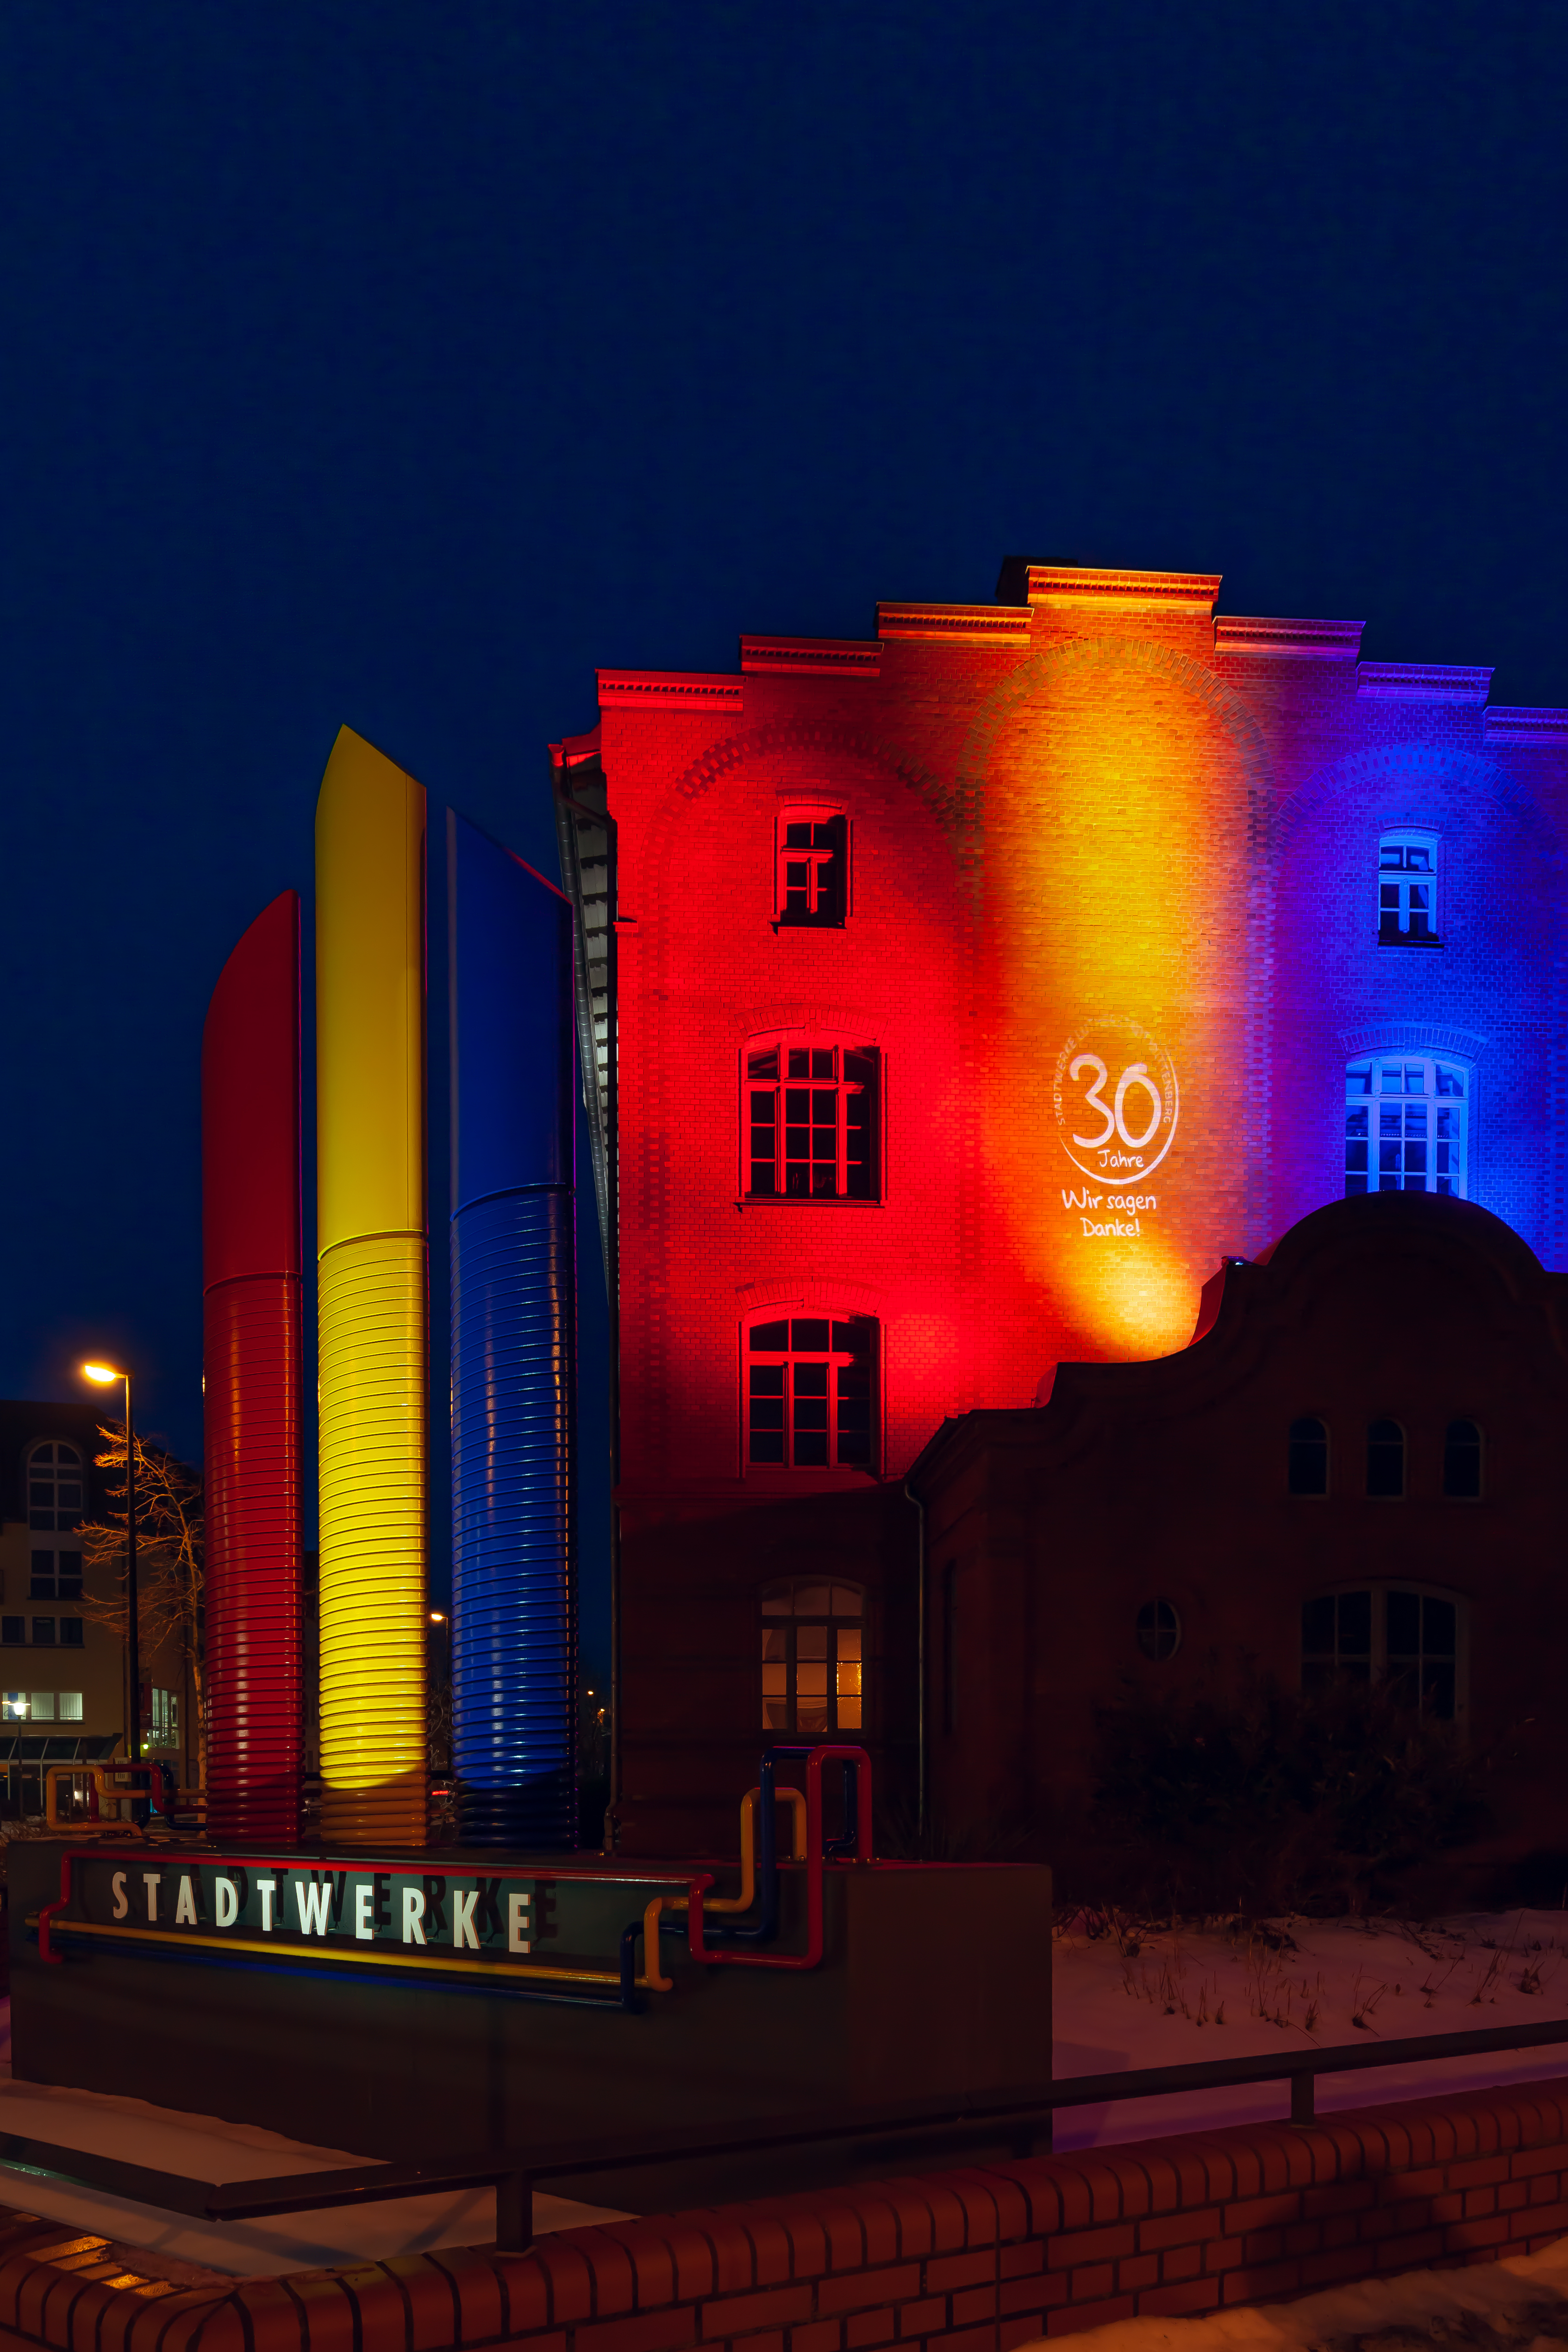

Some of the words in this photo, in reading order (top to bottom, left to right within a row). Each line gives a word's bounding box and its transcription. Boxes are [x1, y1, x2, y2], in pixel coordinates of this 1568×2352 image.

[1069, 1053, 1162, 1148] 30
[1098, 1149, 1144, 1168] Jahre
[1062, 1187, 1103, 1209] Wir
[1107, 1195, 1156, 1216] sagen
[1080, 1217, 1140, 1237] Danke!
[112, 1872, 531, 1953] STADTWERKE
